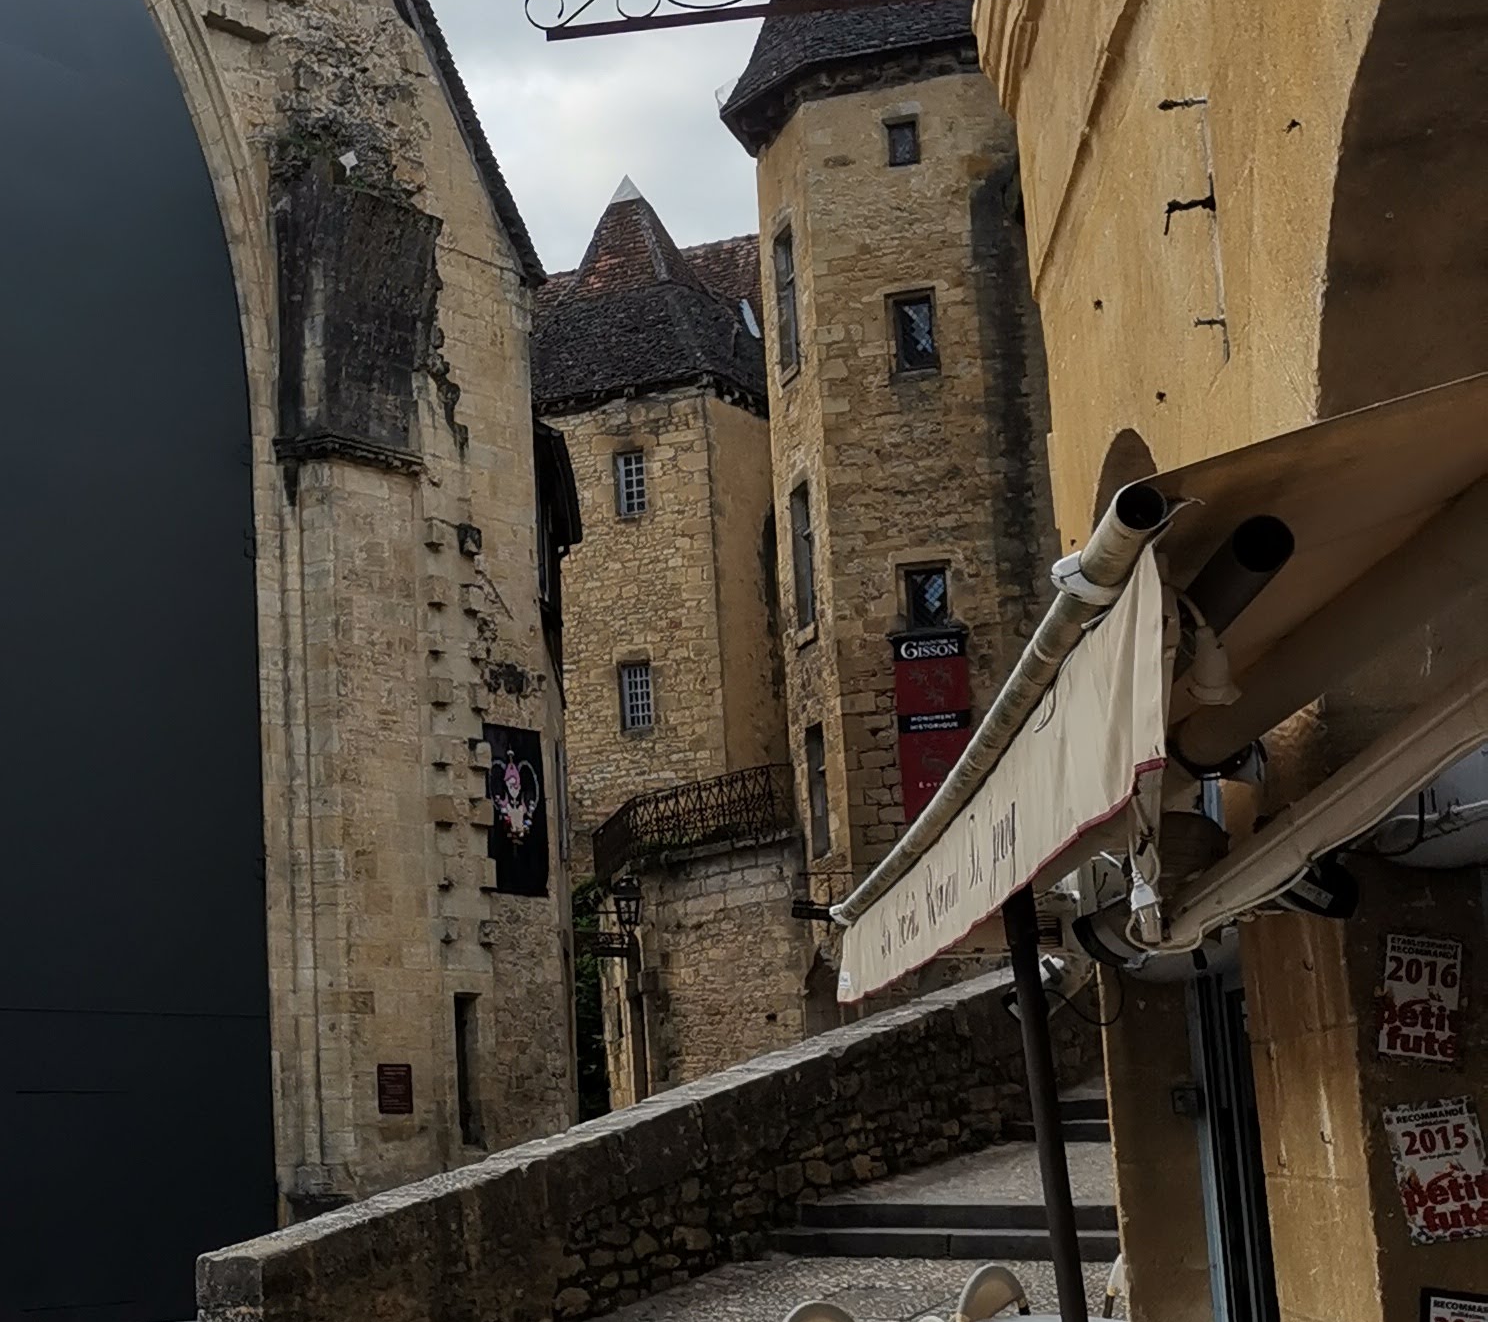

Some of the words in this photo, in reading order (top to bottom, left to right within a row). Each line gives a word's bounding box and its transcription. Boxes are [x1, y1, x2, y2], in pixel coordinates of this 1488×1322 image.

[900, 640, 959, 659] GISSON
[1386, 955, 1458, 988] 2016
[1401, 1123, 1469, 1157] 2015
